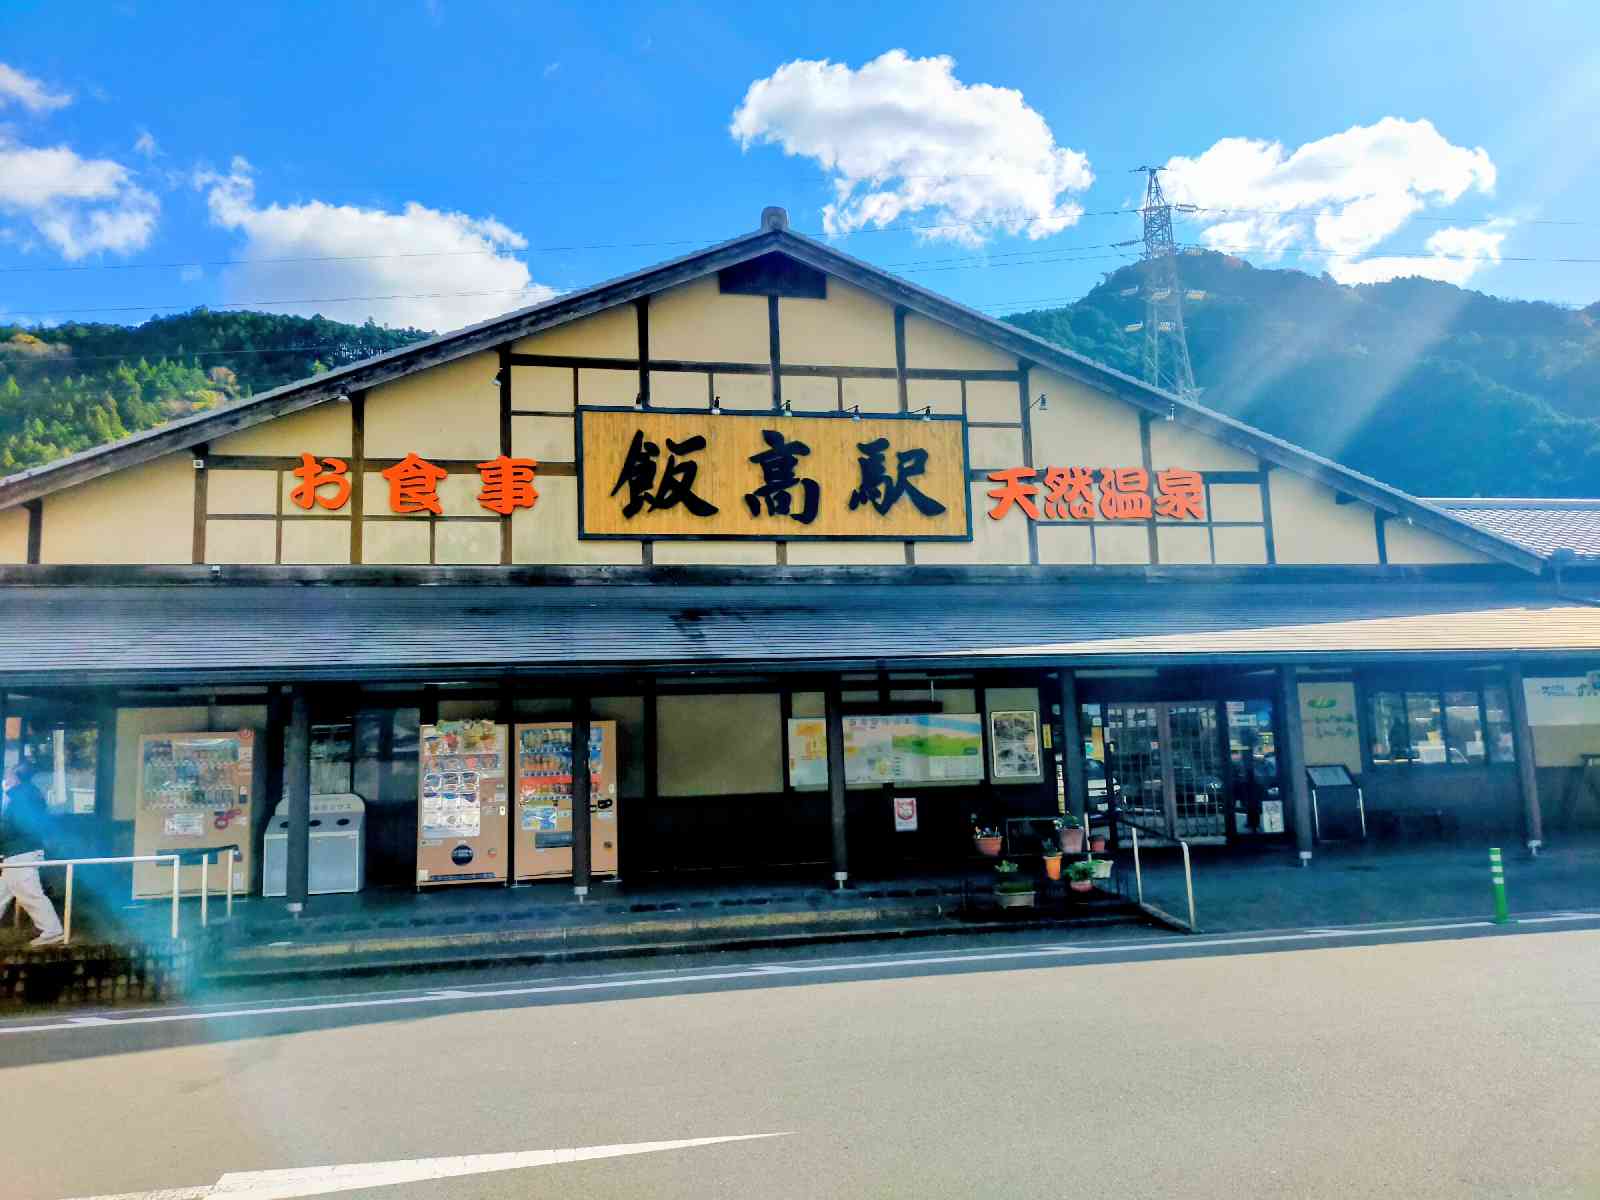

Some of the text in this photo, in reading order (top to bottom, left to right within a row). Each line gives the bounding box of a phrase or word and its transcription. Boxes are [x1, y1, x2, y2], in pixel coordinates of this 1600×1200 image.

[290, 452, 538, 514] お食事
[611, 429, 946, 524] 飯高駅
[987, 466, 1205, 520] 天然温泉
